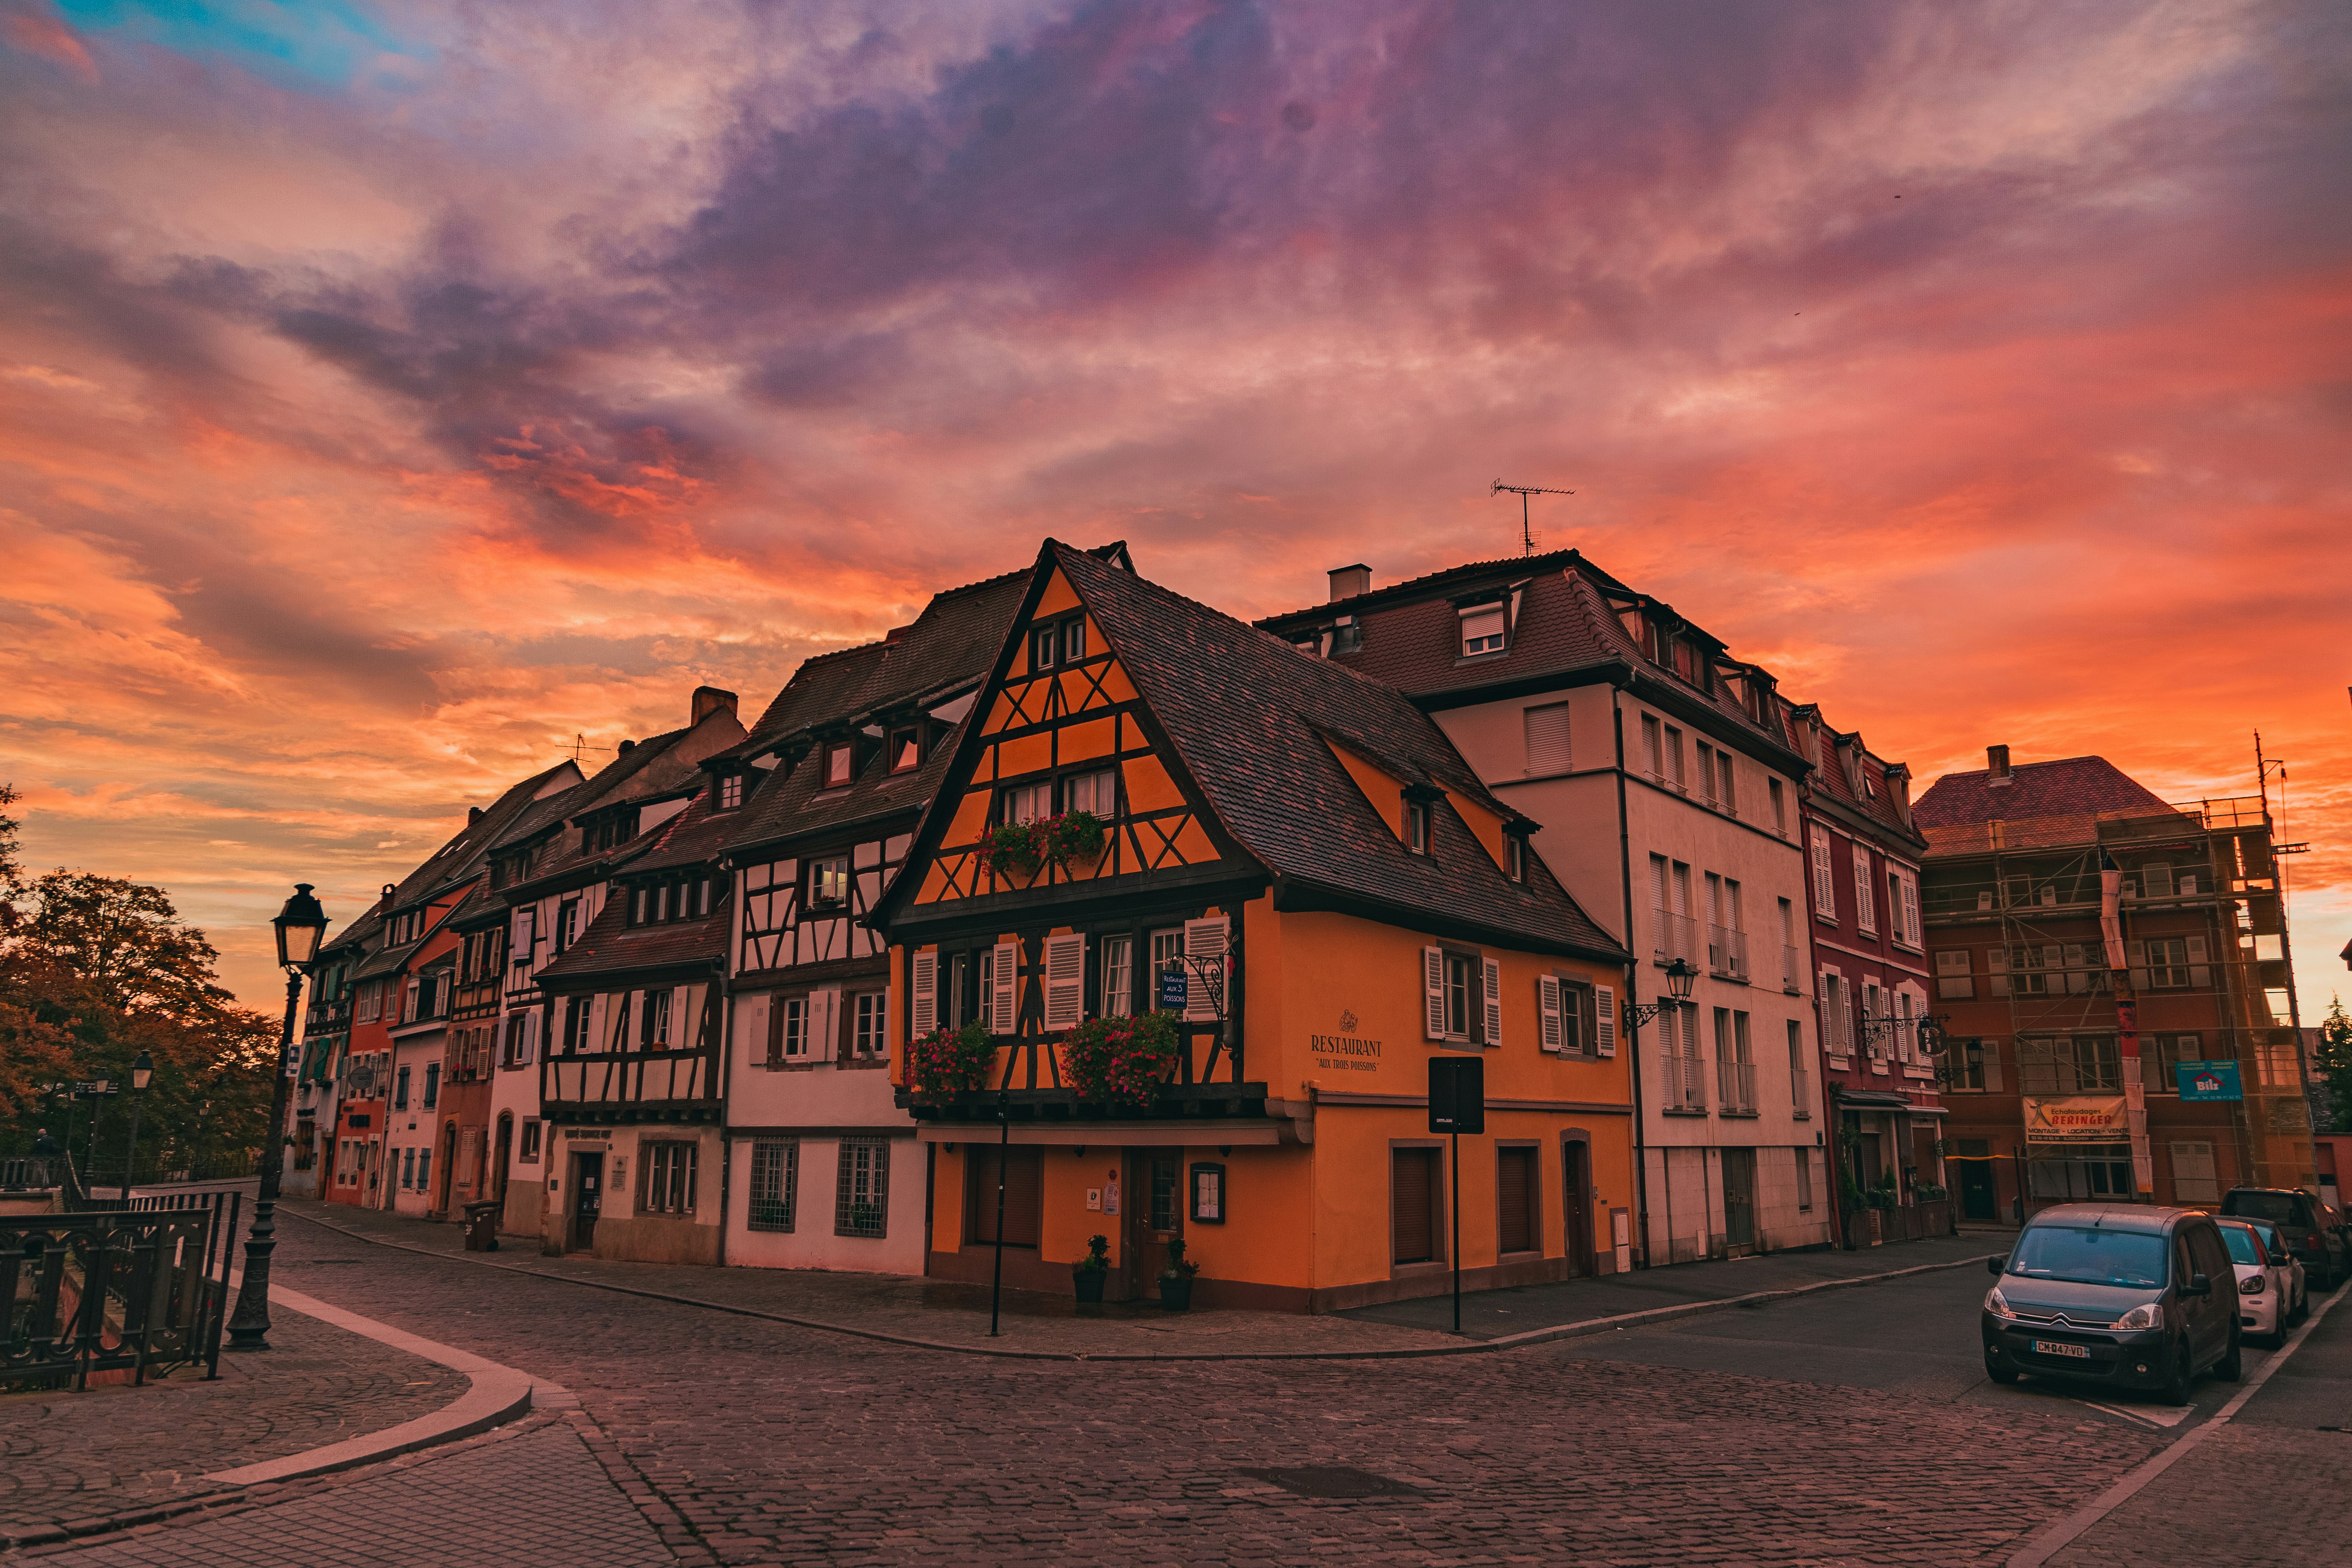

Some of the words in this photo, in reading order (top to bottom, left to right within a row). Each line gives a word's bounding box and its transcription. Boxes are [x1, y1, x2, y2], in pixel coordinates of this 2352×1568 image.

[1311, 1034, 1382, 1057] RESTAURANT
[1919, 1049, 1948, 1058] RESTAURANT
[1333, 1059, 1349, 1070] TROIS
[2196, 1079, 2219, 1091] Bilz
[2052, 1115, 2112, 1124] BERINGER
